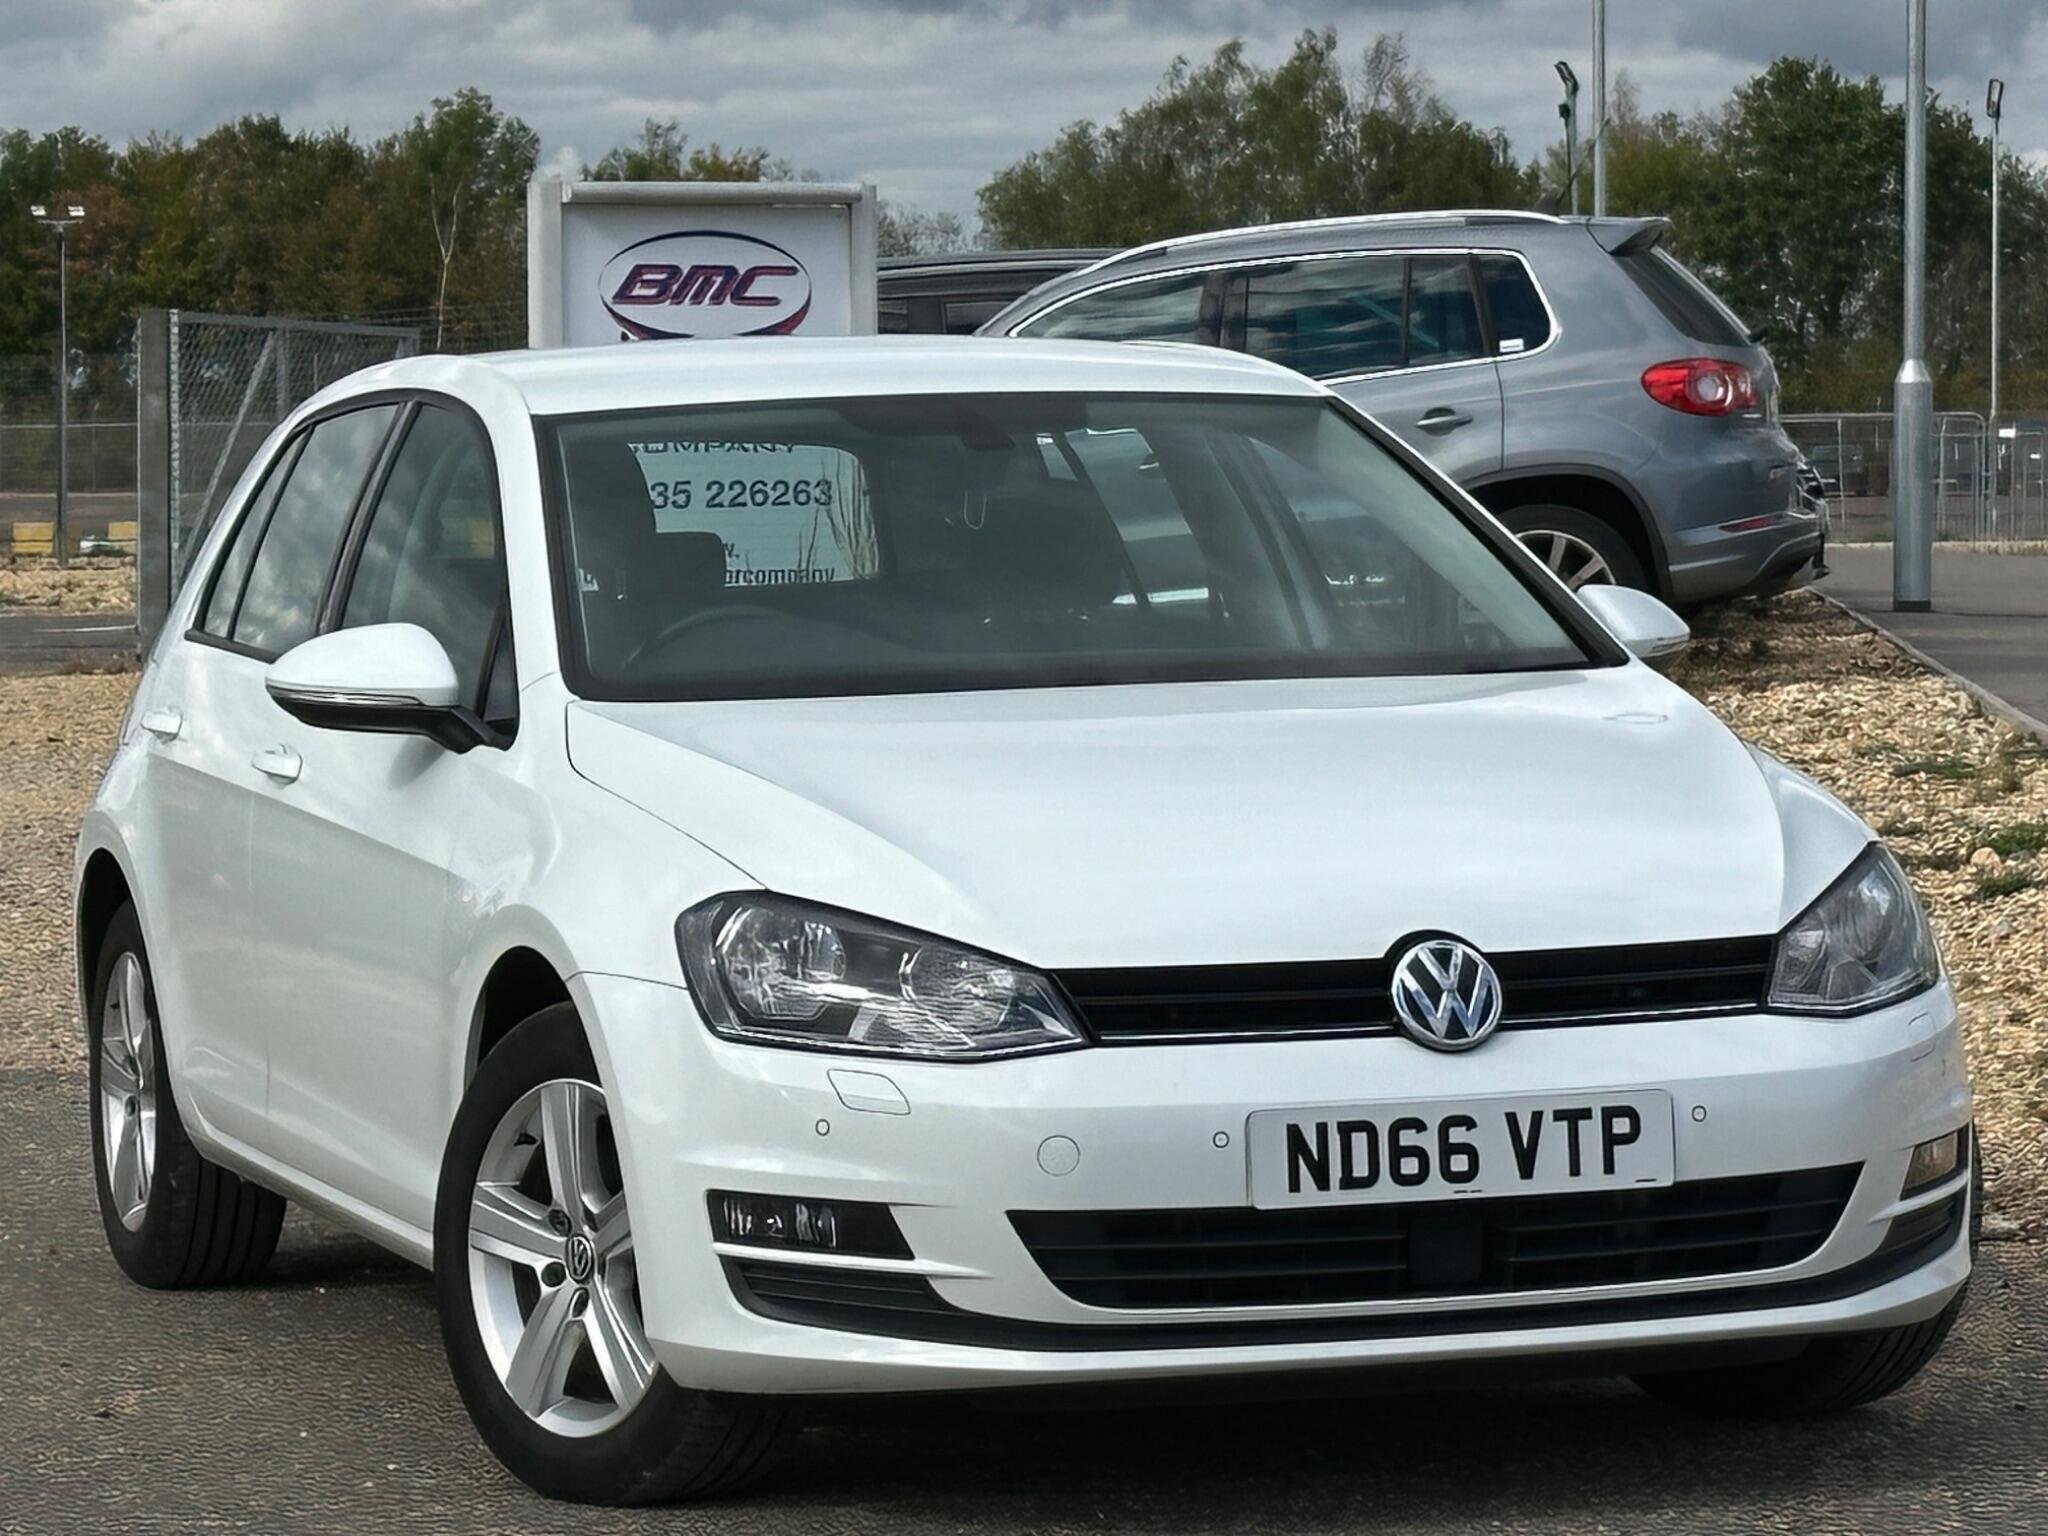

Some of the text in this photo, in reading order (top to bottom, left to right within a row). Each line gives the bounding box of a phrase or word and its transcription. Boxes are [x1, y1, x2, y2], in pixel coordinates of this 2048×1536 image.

[611, 264, 799, 306] BMC
[705, 480, 833, 508] 226263
[1286, 1105, 1642, 1194] ND66 VTP
